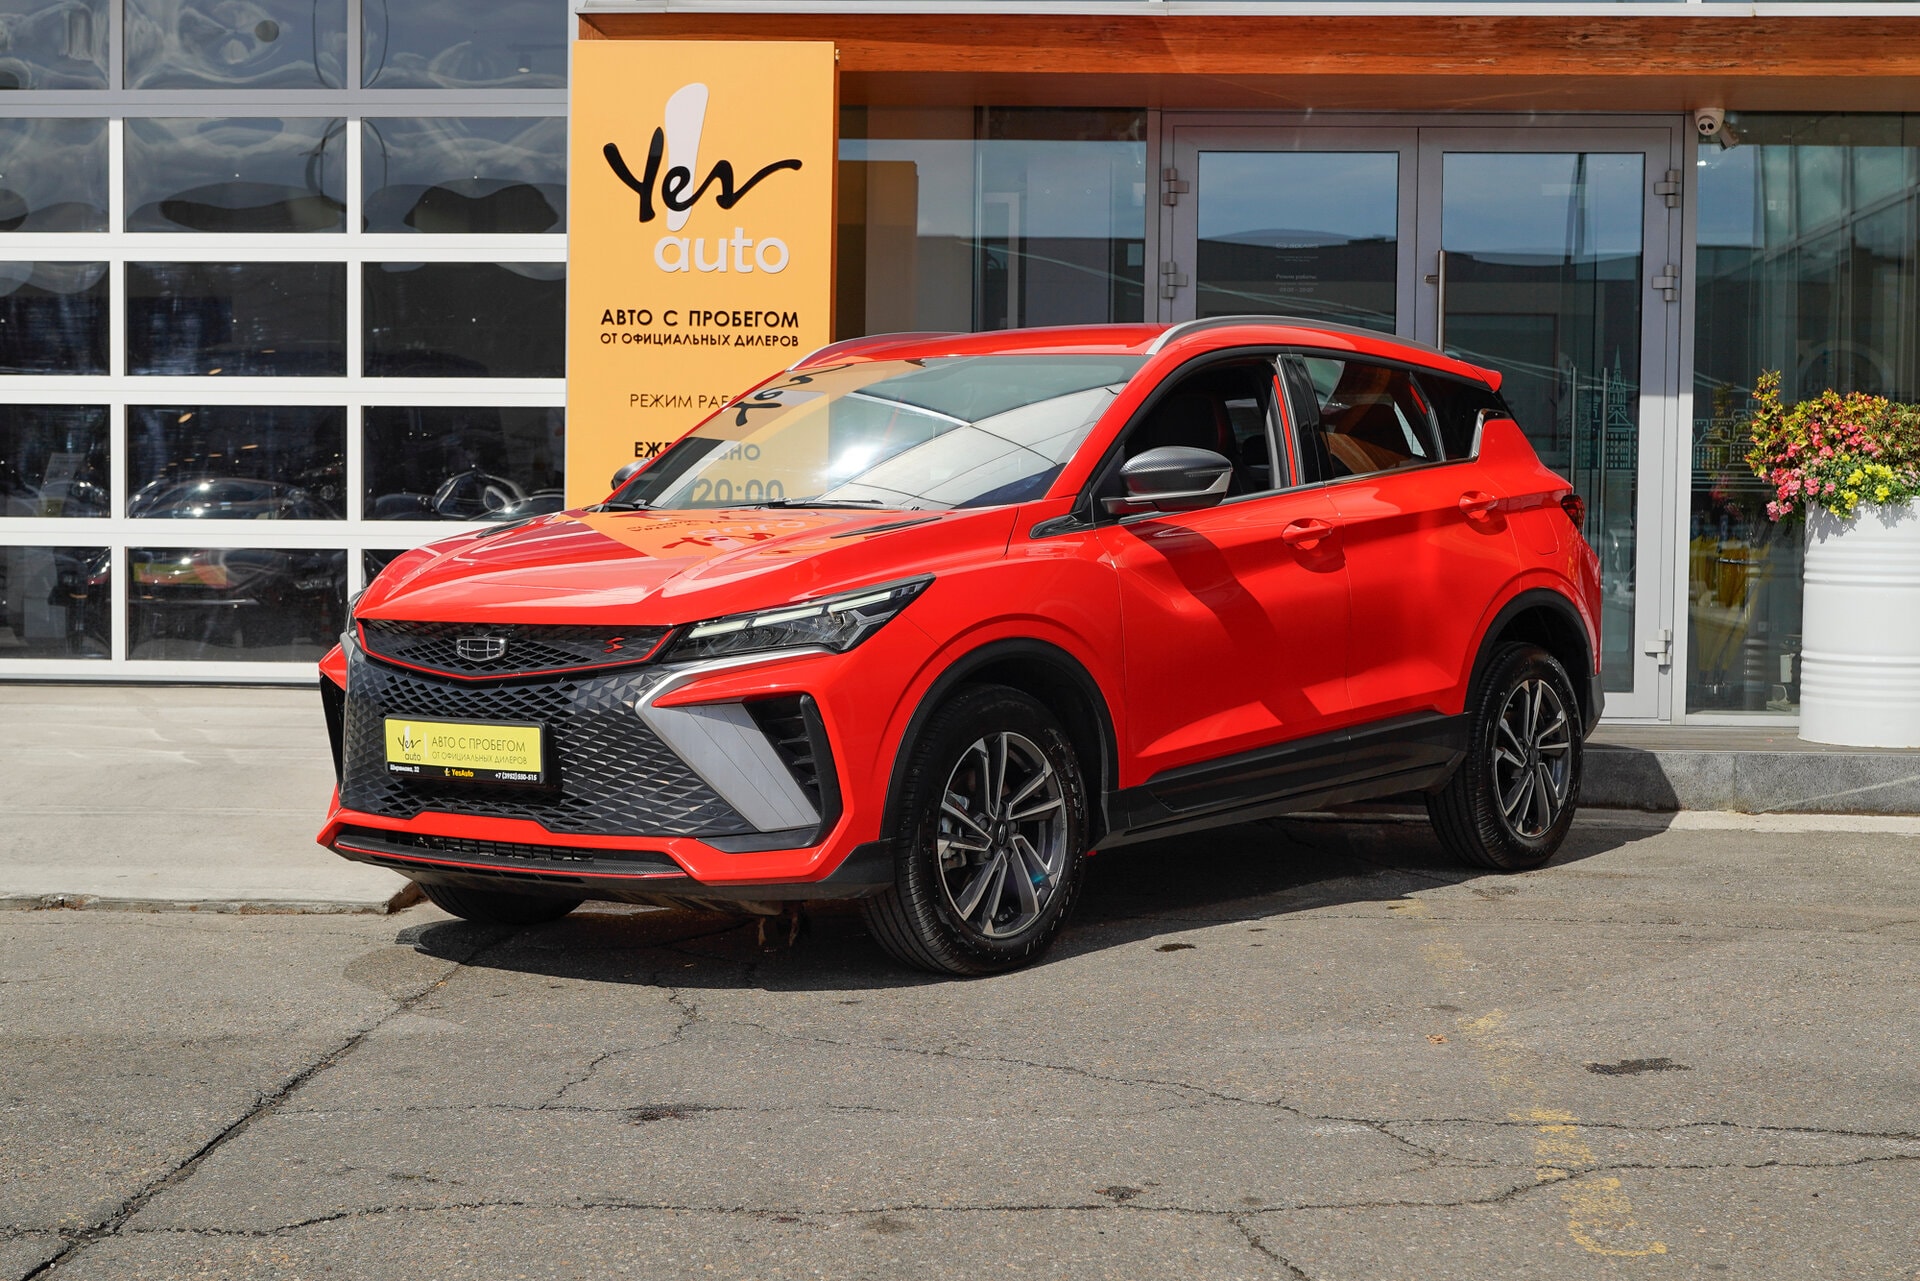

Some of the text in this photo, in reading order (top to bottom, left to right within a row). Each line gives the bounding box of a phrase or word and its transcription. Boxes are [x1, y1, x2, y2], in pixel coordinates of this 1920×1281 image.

[602, 125, 803, 223] Yes
[653, 226, 791, 274] auto
[600, 309, 799, 328] АВТО С ПРОБЕГОМ
[600, 333, 799, 347] ОТ ОФИЦИАЛЬНЫХ ДИЛЕРОВ
[629, 394, 693, 409] РЕЖИМ
[397, 734, 421, 751] Yes
[432, 736, 526, 752] АВТО С ПРОБЕГОМ
[405, 753, 421, 761] auto
[432, 751, 440, 760] ОТ
[494, 755, 527, 765] ДИЛЕРОВ
[451, 769, 474, 778] YesAuto
